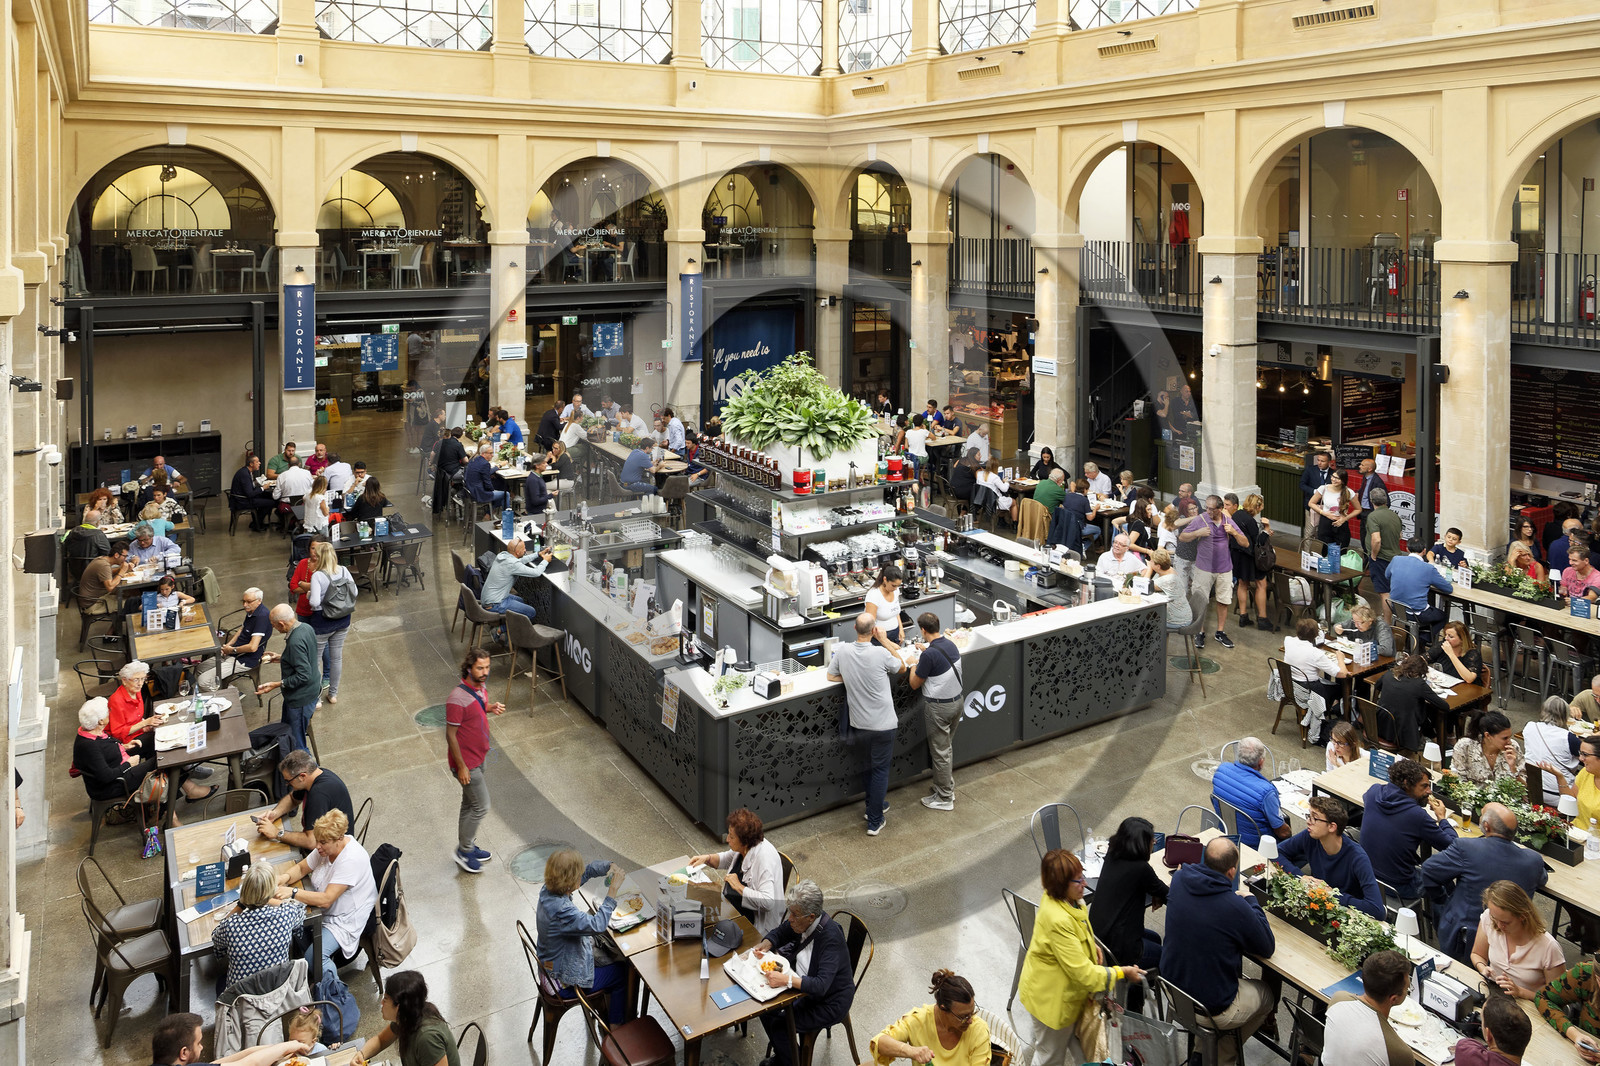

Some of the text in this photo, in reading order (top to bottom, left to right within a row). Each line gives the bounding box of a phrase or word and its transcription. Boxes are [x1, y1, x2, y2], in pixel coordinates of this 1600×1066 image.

[1171, 202, 1191, 211] MOG
[296, 290, 304, 383] RISTORANTE
[723, 352, 740, 371] you
[741, 341, 762, 359] need
[761, 345, 771, 355] is
[564, 629, 592, 674] MOG
[959, 684, 1007, 721] OG
[1430, 993, 1448, 1008] MOG
